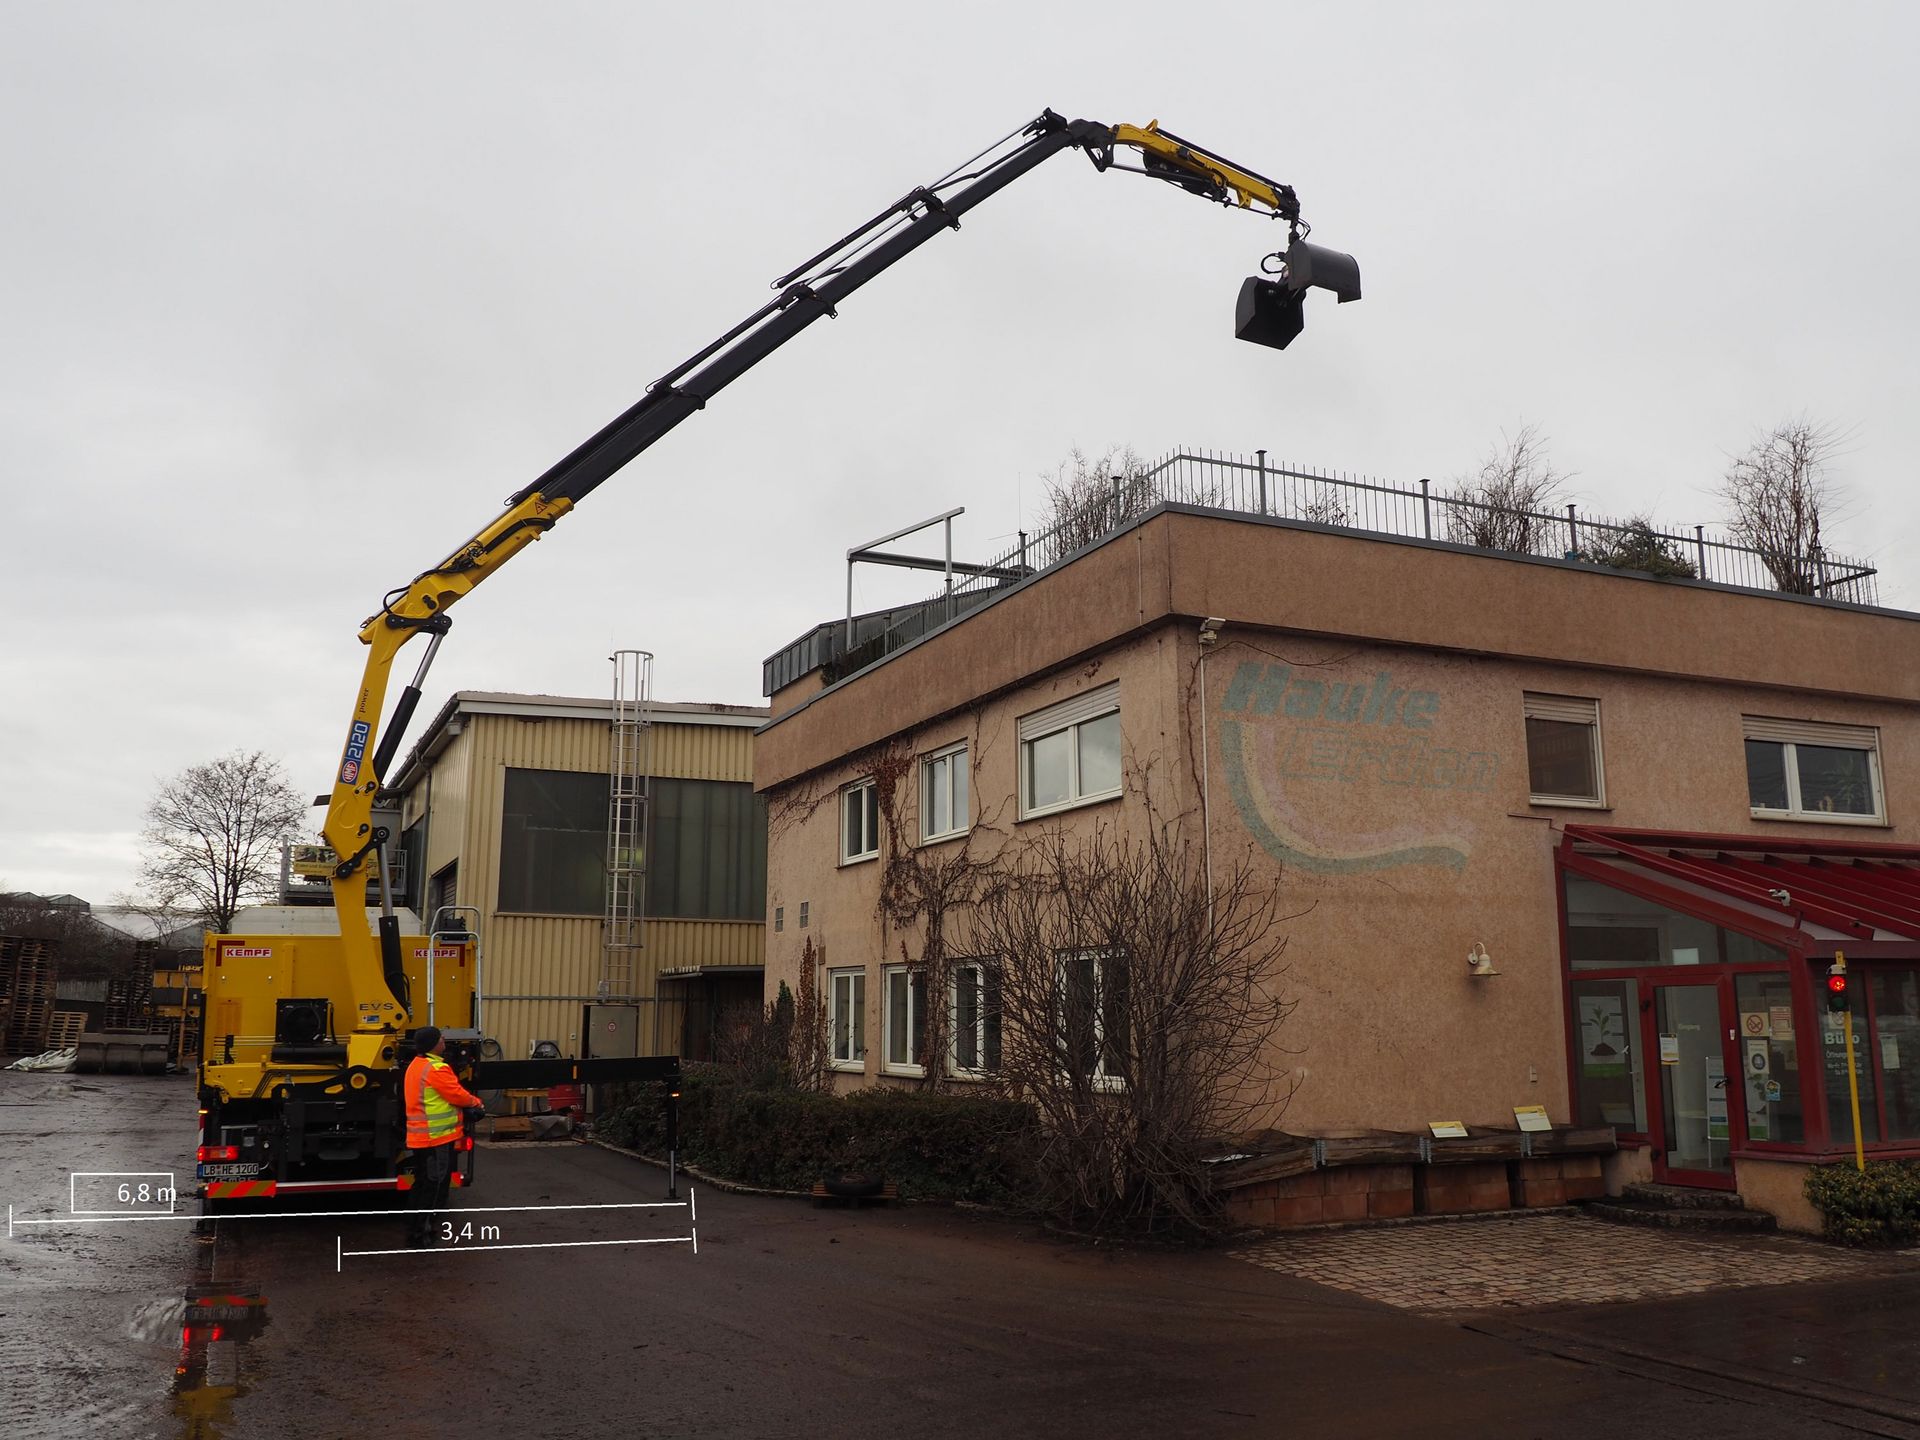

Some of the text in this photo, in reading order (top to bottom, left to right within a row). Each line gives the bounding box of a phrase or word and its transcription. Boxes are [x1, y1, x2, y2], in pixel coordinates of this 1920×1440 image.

[1221, 661, 1441, 729] Hauke
[348, 723, 368, 759] 2120
[226, 949, 271, 957] KEMPF
[359, 1002, 394, 1011] EVS
[1824, 1031, 1860, 1045] Büo
[204, 1164, 258, 1175] LB HE 1200
